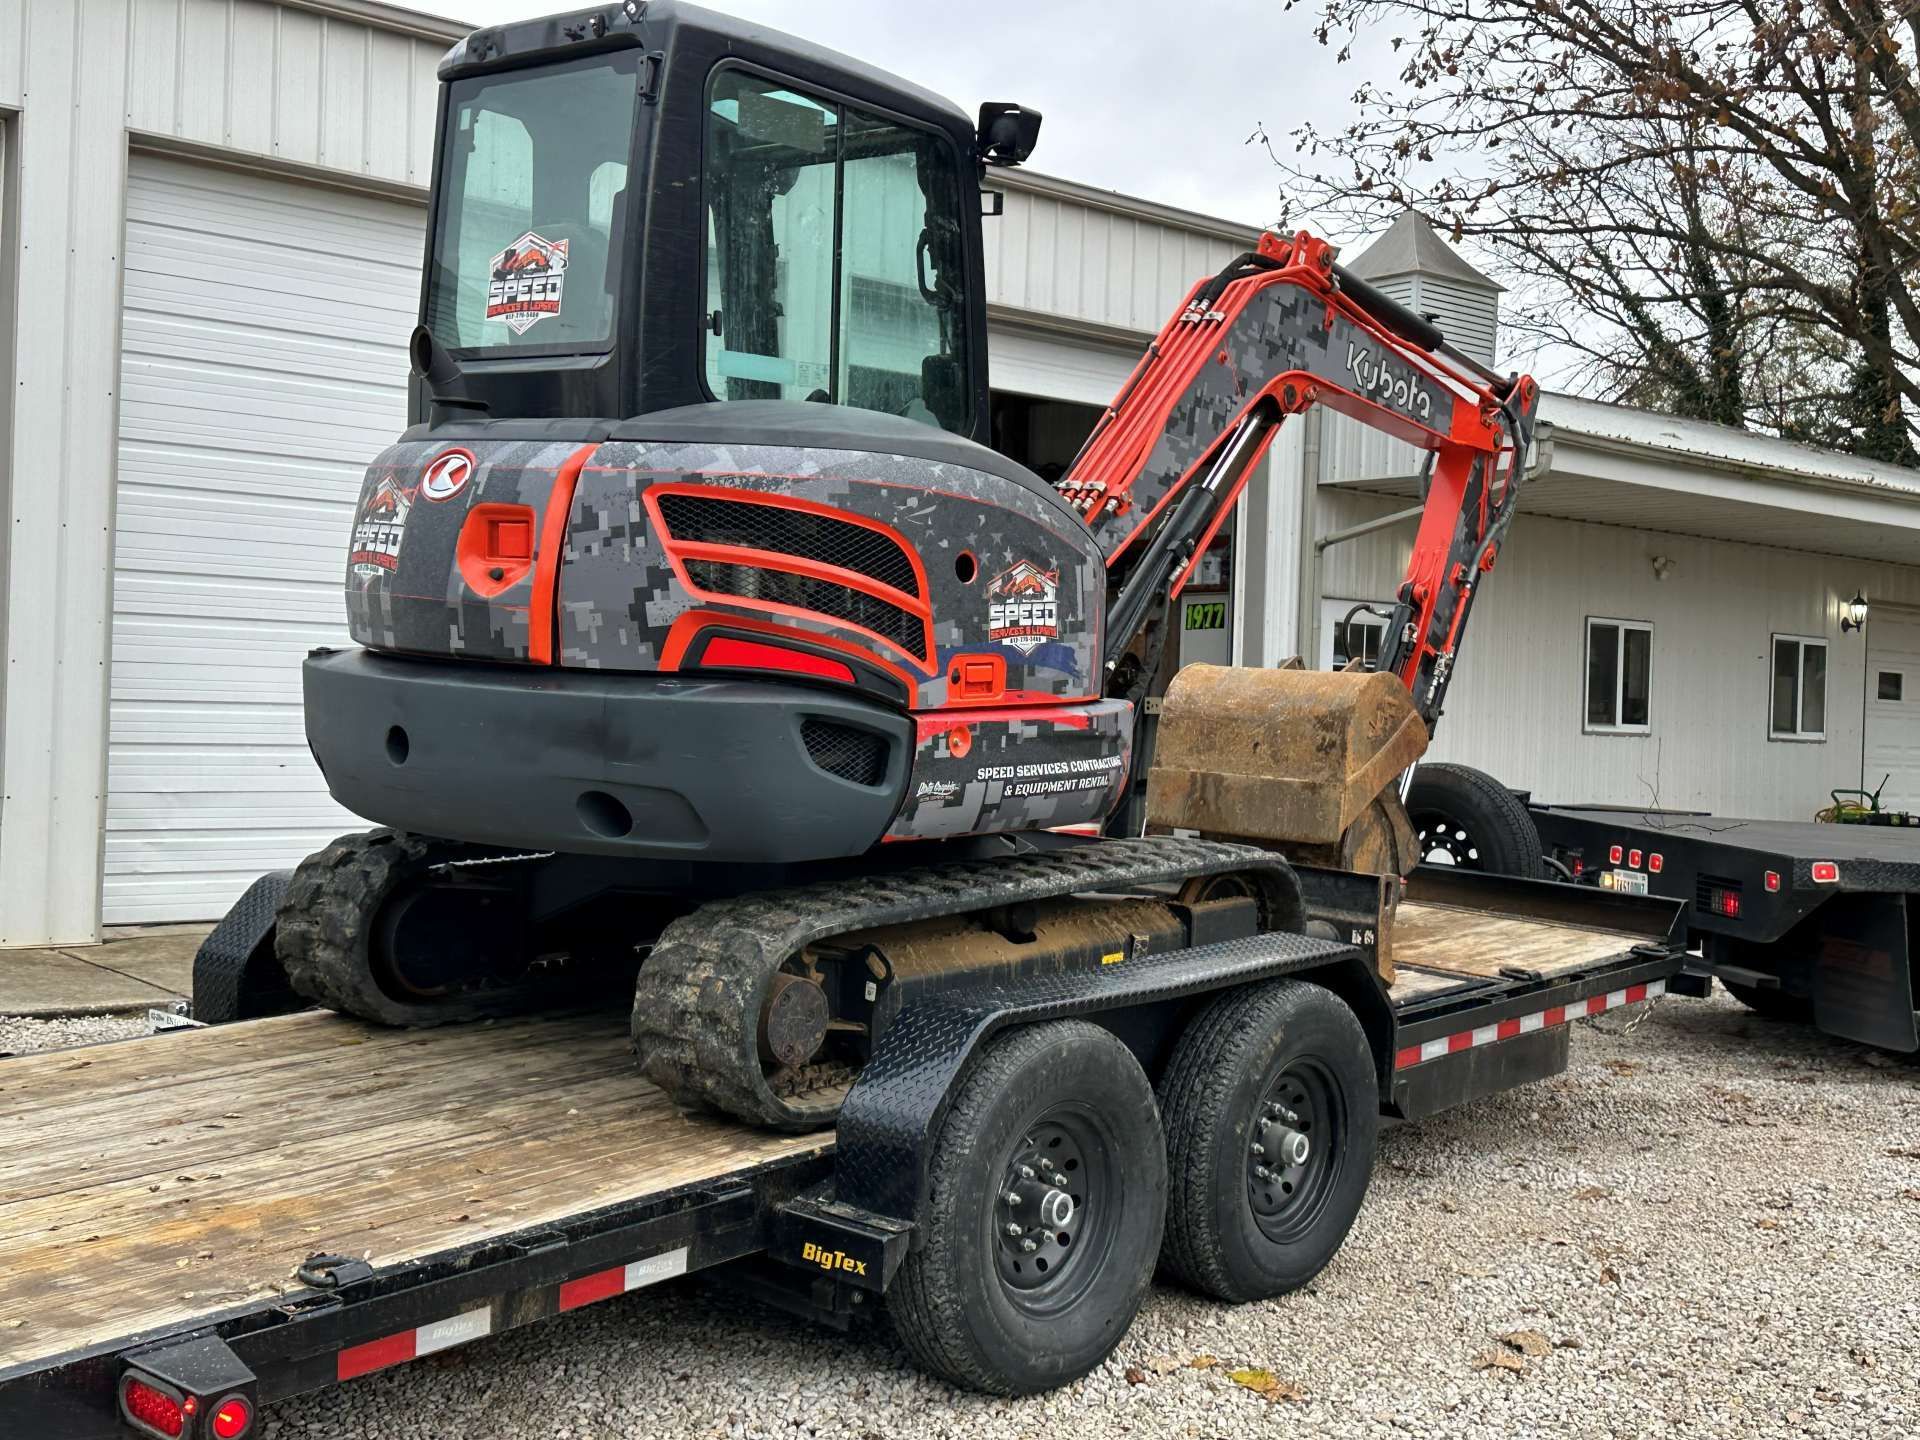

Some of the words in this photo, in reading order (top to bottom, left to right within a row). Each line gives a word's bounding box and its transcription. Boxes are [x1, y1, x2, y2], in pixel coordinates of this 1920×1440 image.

[488, 275, 562, 307] SPEED
[1346, 341, 1431, 419] Kubota
[352, 523, 404, 557] SPEED
[990, 603, 1057, 629] SPEED
[1186, 604, 1224, 629] 1977
[977, 766, 1014, 780] SPEED
[1016, 761, 1069, 777] SERVICES
[1070, 755, 1122, 773] CONTRACTING
[1004, 786, 1013, 796] &
[1015, 780, 1078, 797] EQUIPMENT
[1078, 775, 1109, 790] RENTAL
[802, 1242, 867, 1276] BigTex
